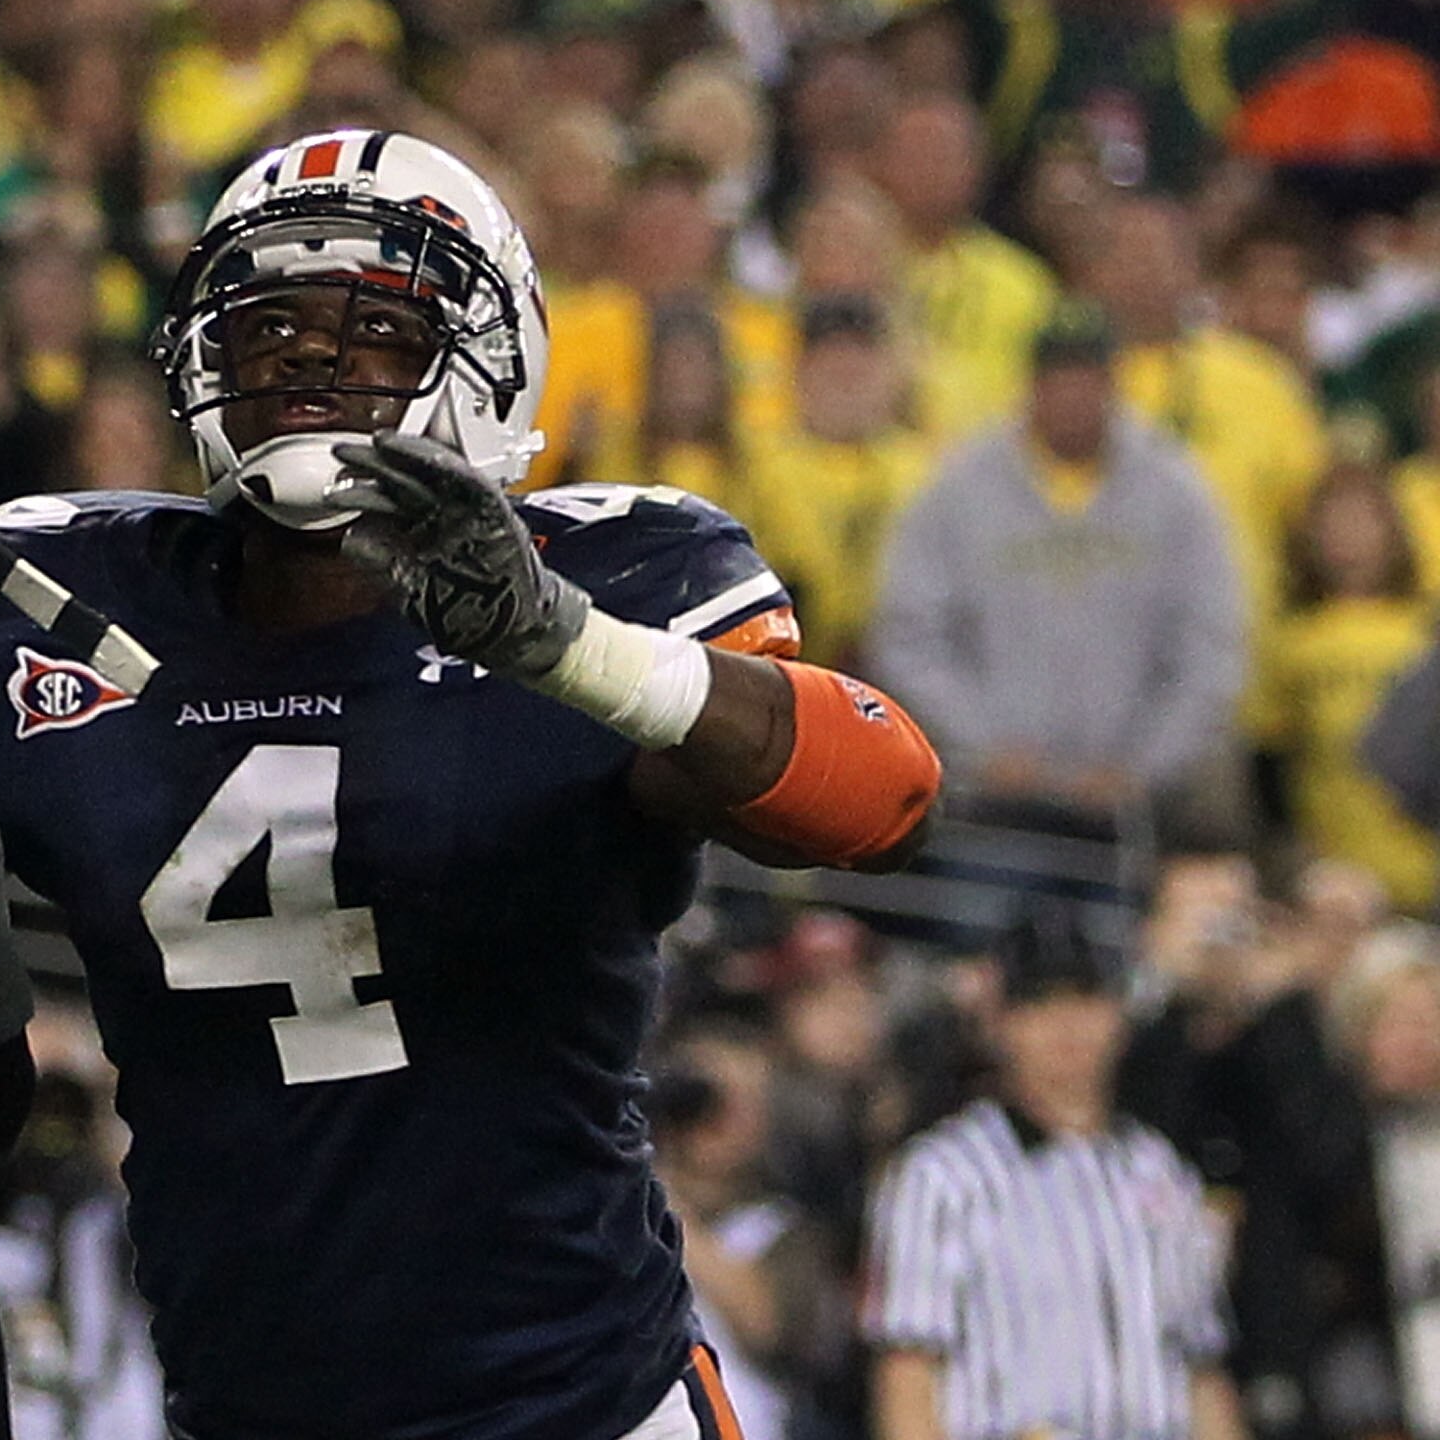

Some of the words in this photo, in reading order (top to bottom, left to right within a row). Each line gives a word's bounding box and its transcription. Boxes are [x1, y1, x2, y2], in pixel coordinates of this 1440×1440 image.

[36, 672, 83, 716] SEC
[175, 695, 342, 726] AUBURN
[141, 744, 409, 1084] 4
